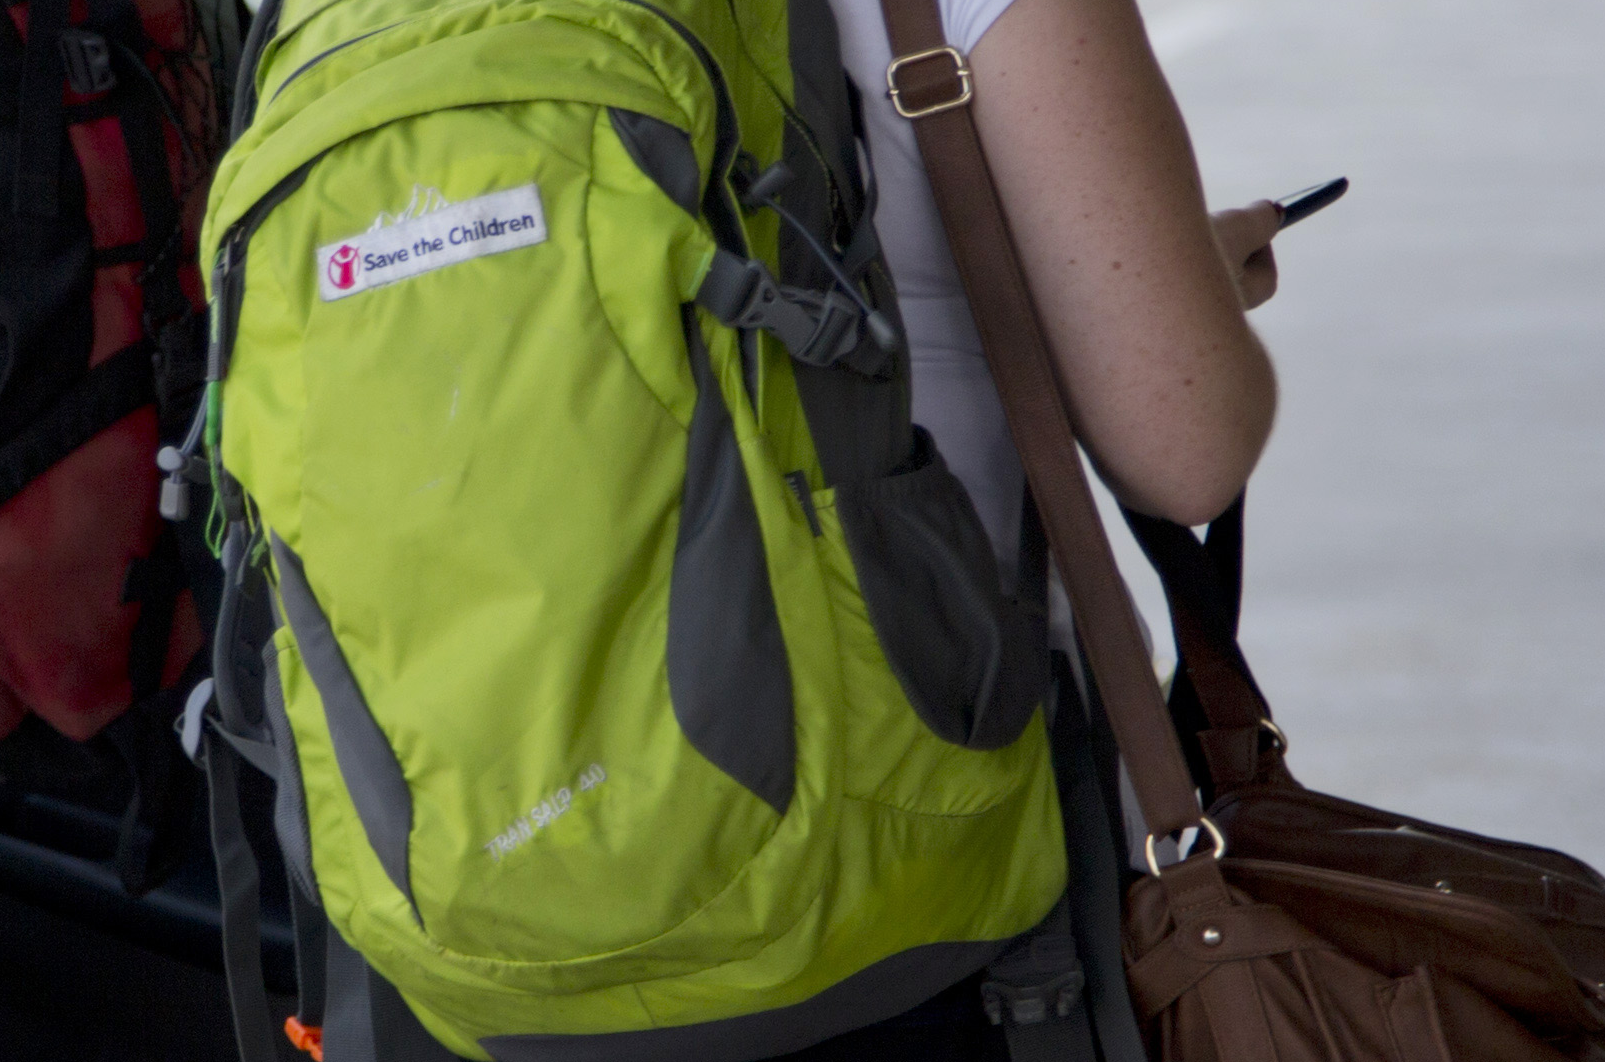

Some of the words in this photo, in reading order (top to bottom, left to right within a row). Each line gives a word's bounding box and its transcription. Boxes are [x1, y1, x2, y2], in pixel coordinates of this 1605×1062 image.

[364, 250, 409, 272] Save
[413, 238, 444, 257] the
[448, 214, 535, 246] Children
[579, 762, 607, 792] 40
